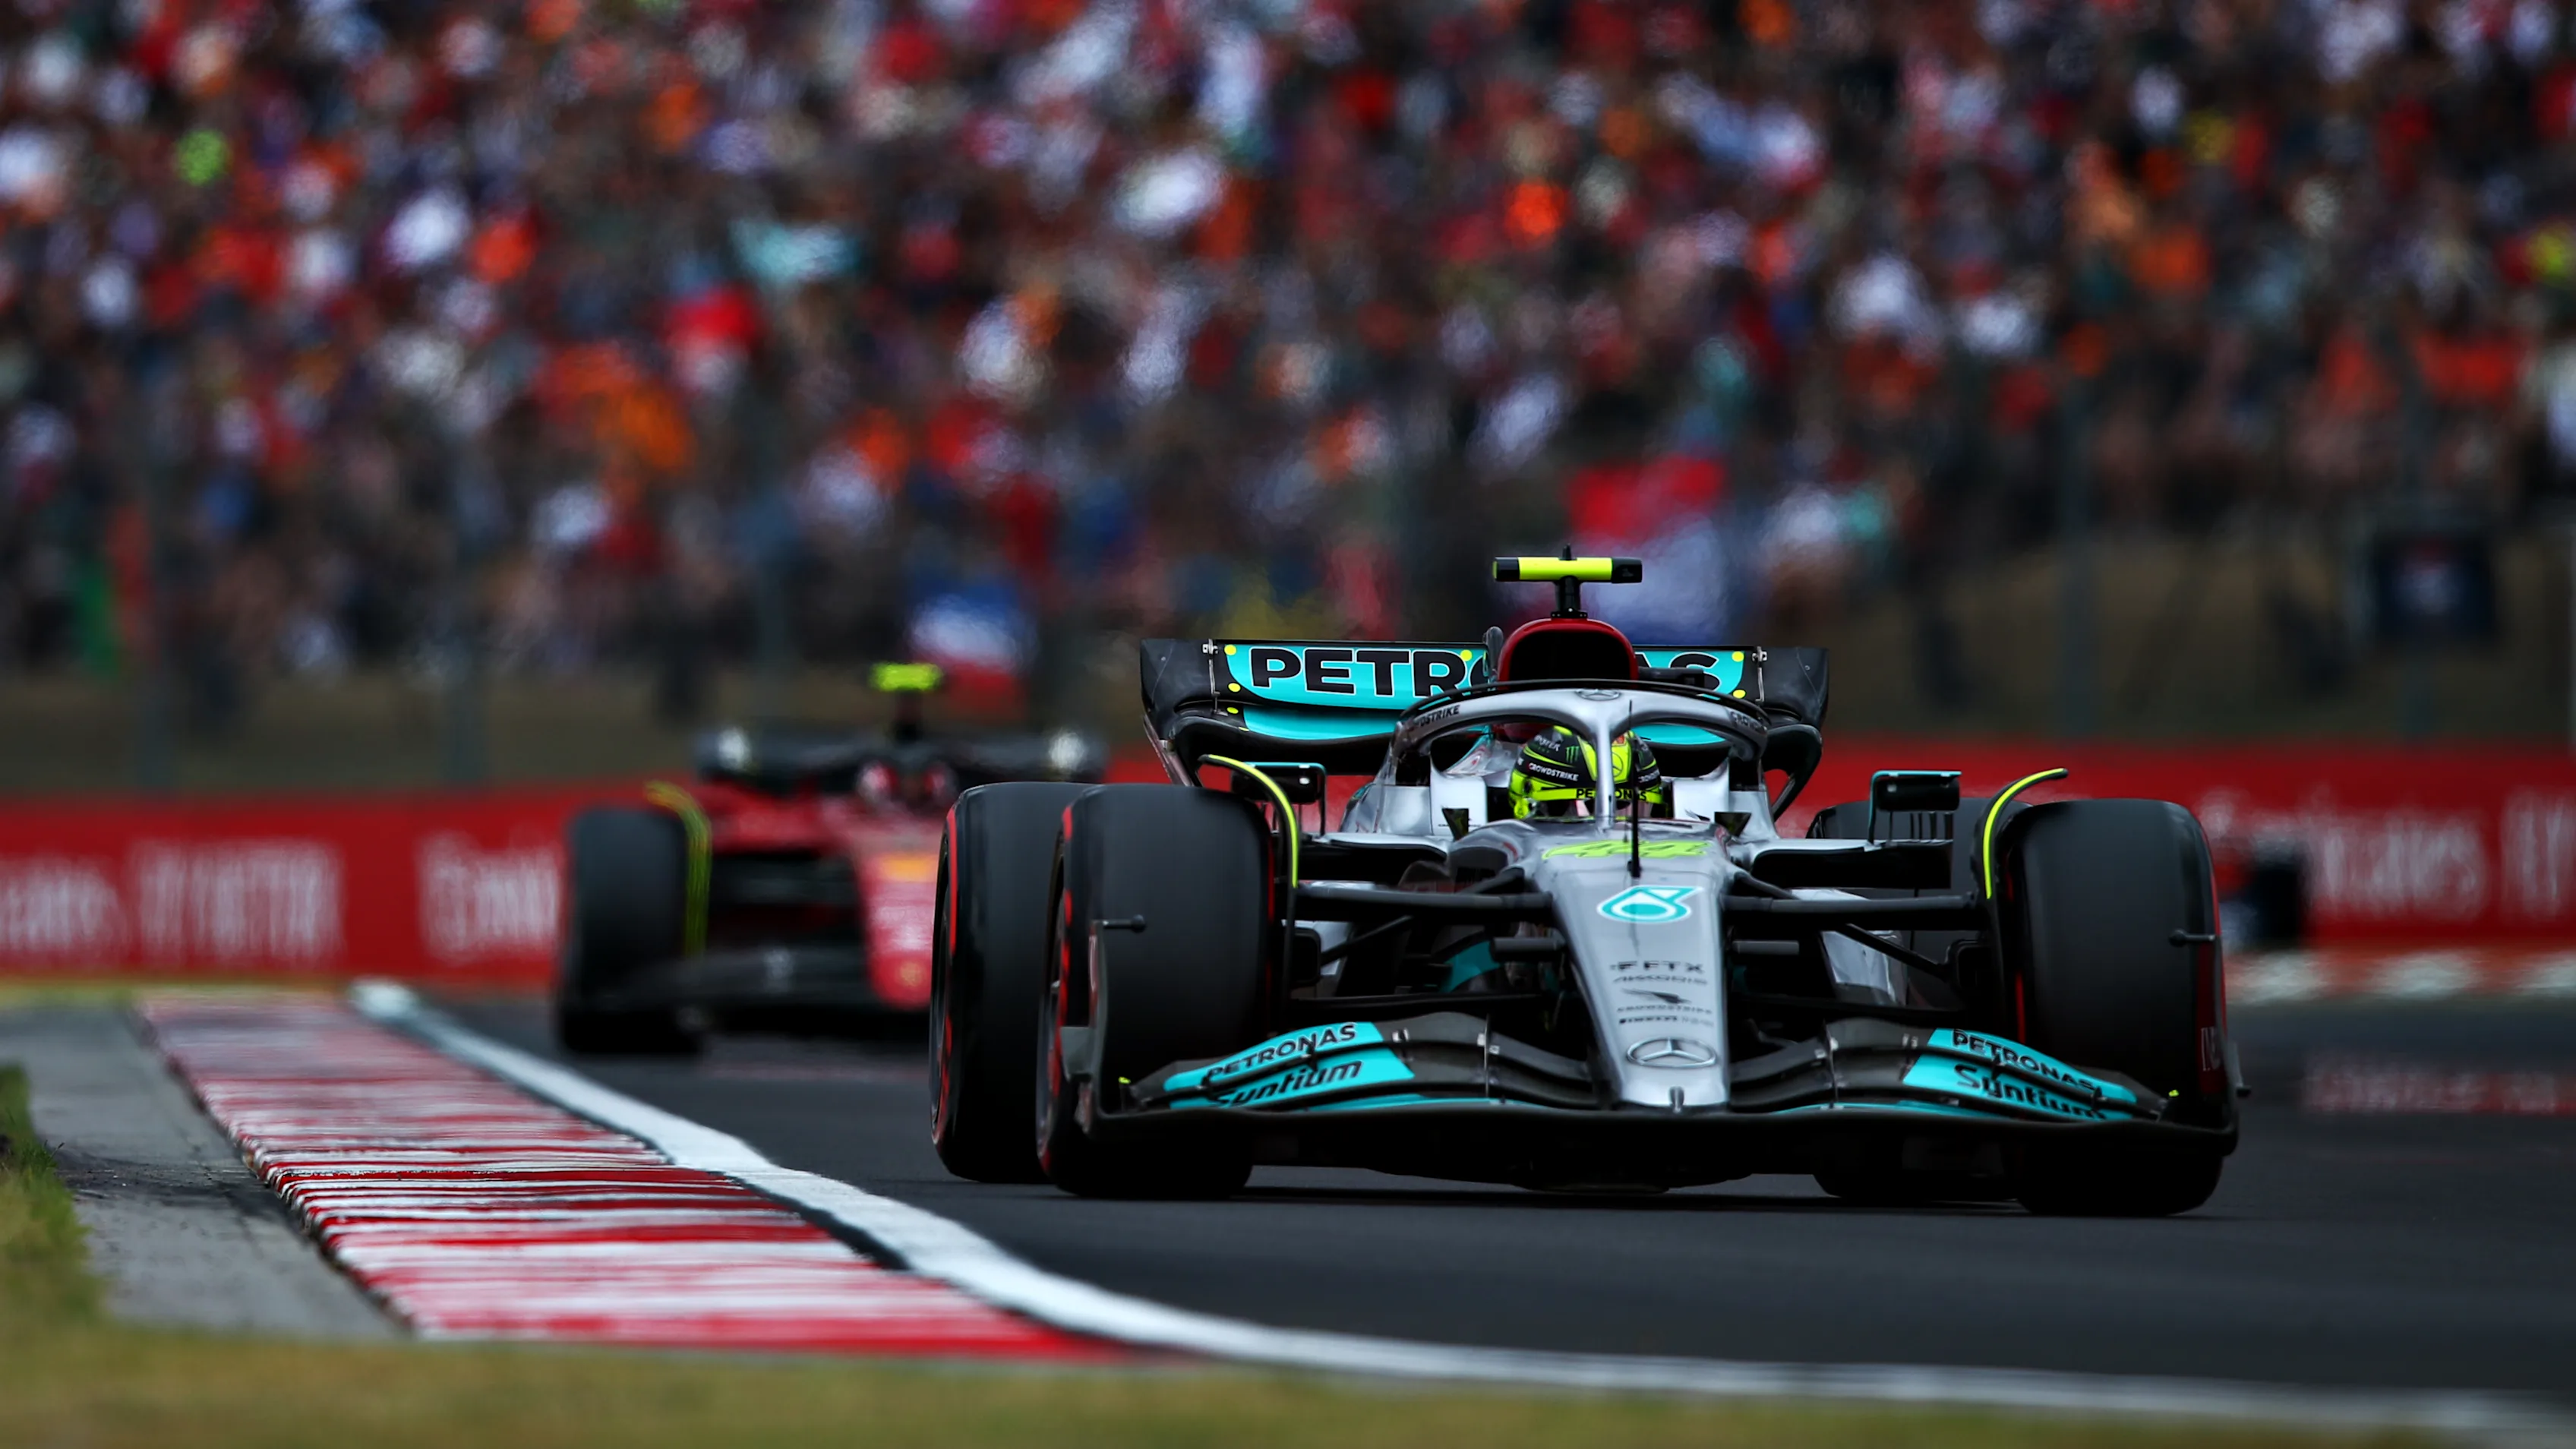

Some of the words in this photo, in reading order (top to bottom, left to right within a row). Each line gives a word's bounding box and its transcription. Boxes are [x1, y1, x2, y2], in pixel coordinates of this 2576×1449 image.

[1249, 646, 1721, 696] PETRS
[1415, 704, 1460, 727] DSTRIKE
[1529, 762, 1579, 782] CROWDSTRIKE
[1576, 788, 1646, 801] PEONS
[1206, 1022, 1357, 1078] PETRONAS
[1952, 1028, 2096, 1091] PETRONAS
[1215, 1060, 1363, 1107] Syntium
[1954, 1063, 2107, 1120] Syntium
